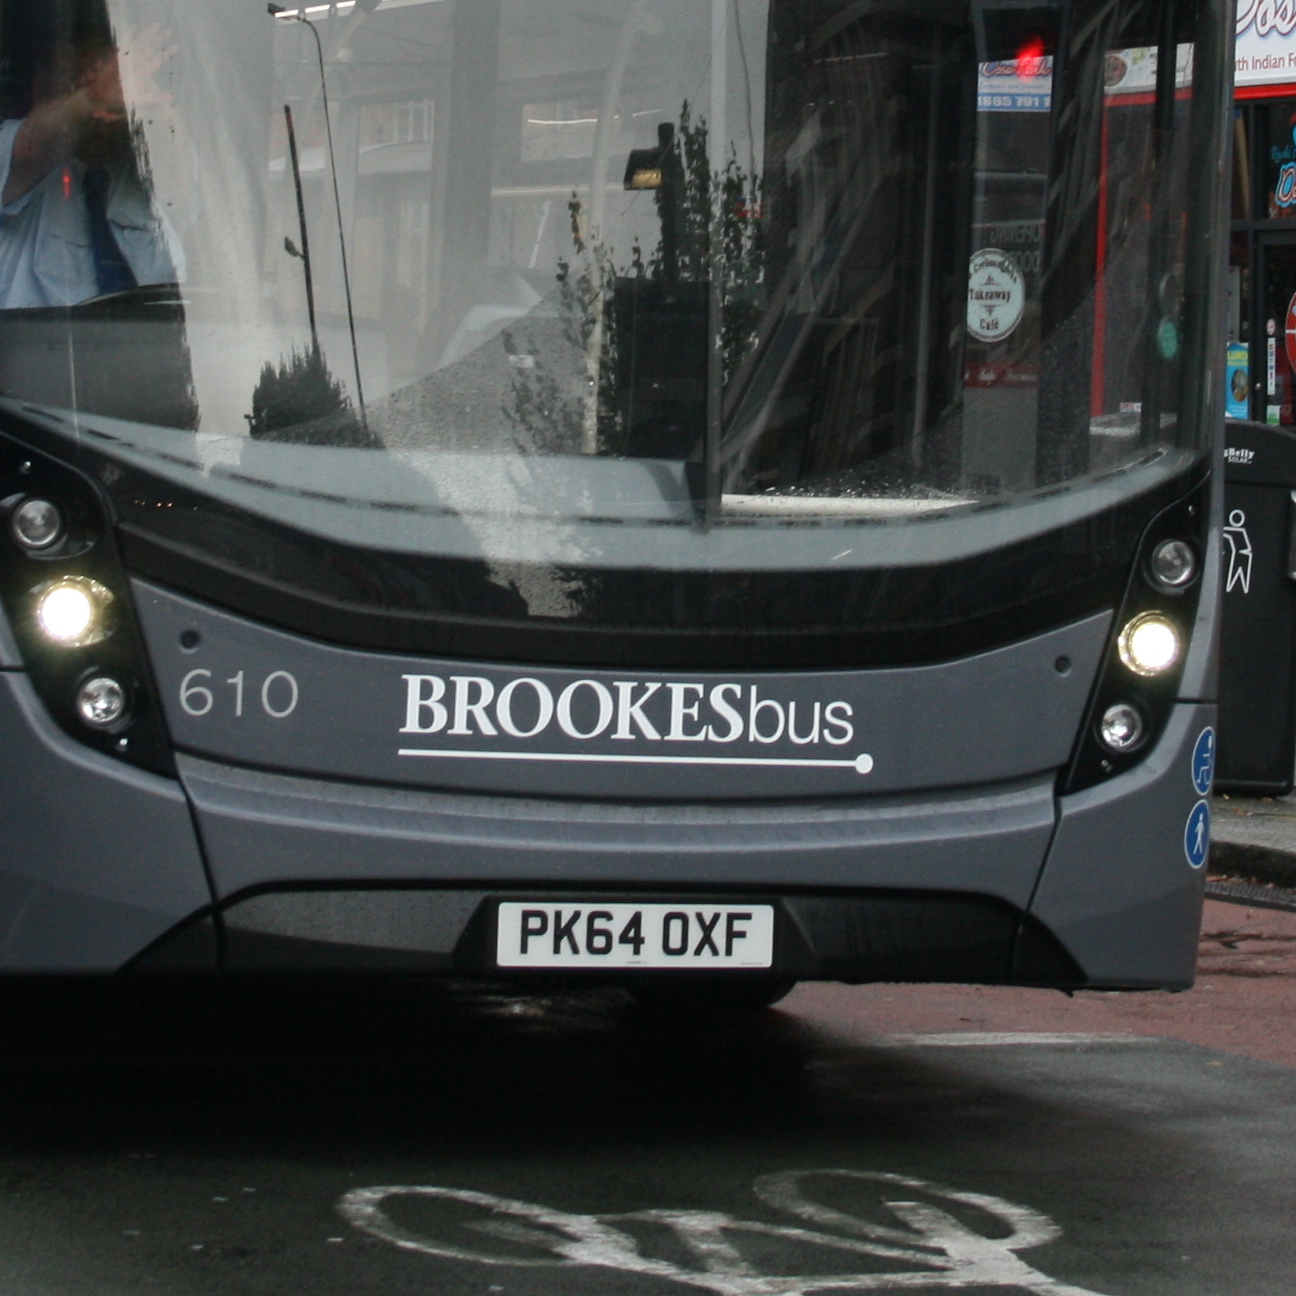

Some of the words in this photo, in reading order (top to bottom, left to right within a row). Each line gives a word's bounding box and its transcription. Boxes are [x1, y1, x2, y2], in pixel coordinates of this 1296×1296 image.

[1251, 53, 1285, 70] Indian
[977, 95, 1013, 107] 1865
[968, 288, 1011, 303] Takeaway
[980, 317, 1000, 331] Café
[178, 668, 299, 718] 610
[399, 673, 854, 745] BROOKESbus
[518, 908, 646, 958] PK64
[662, 910, 753, 958] OXF
